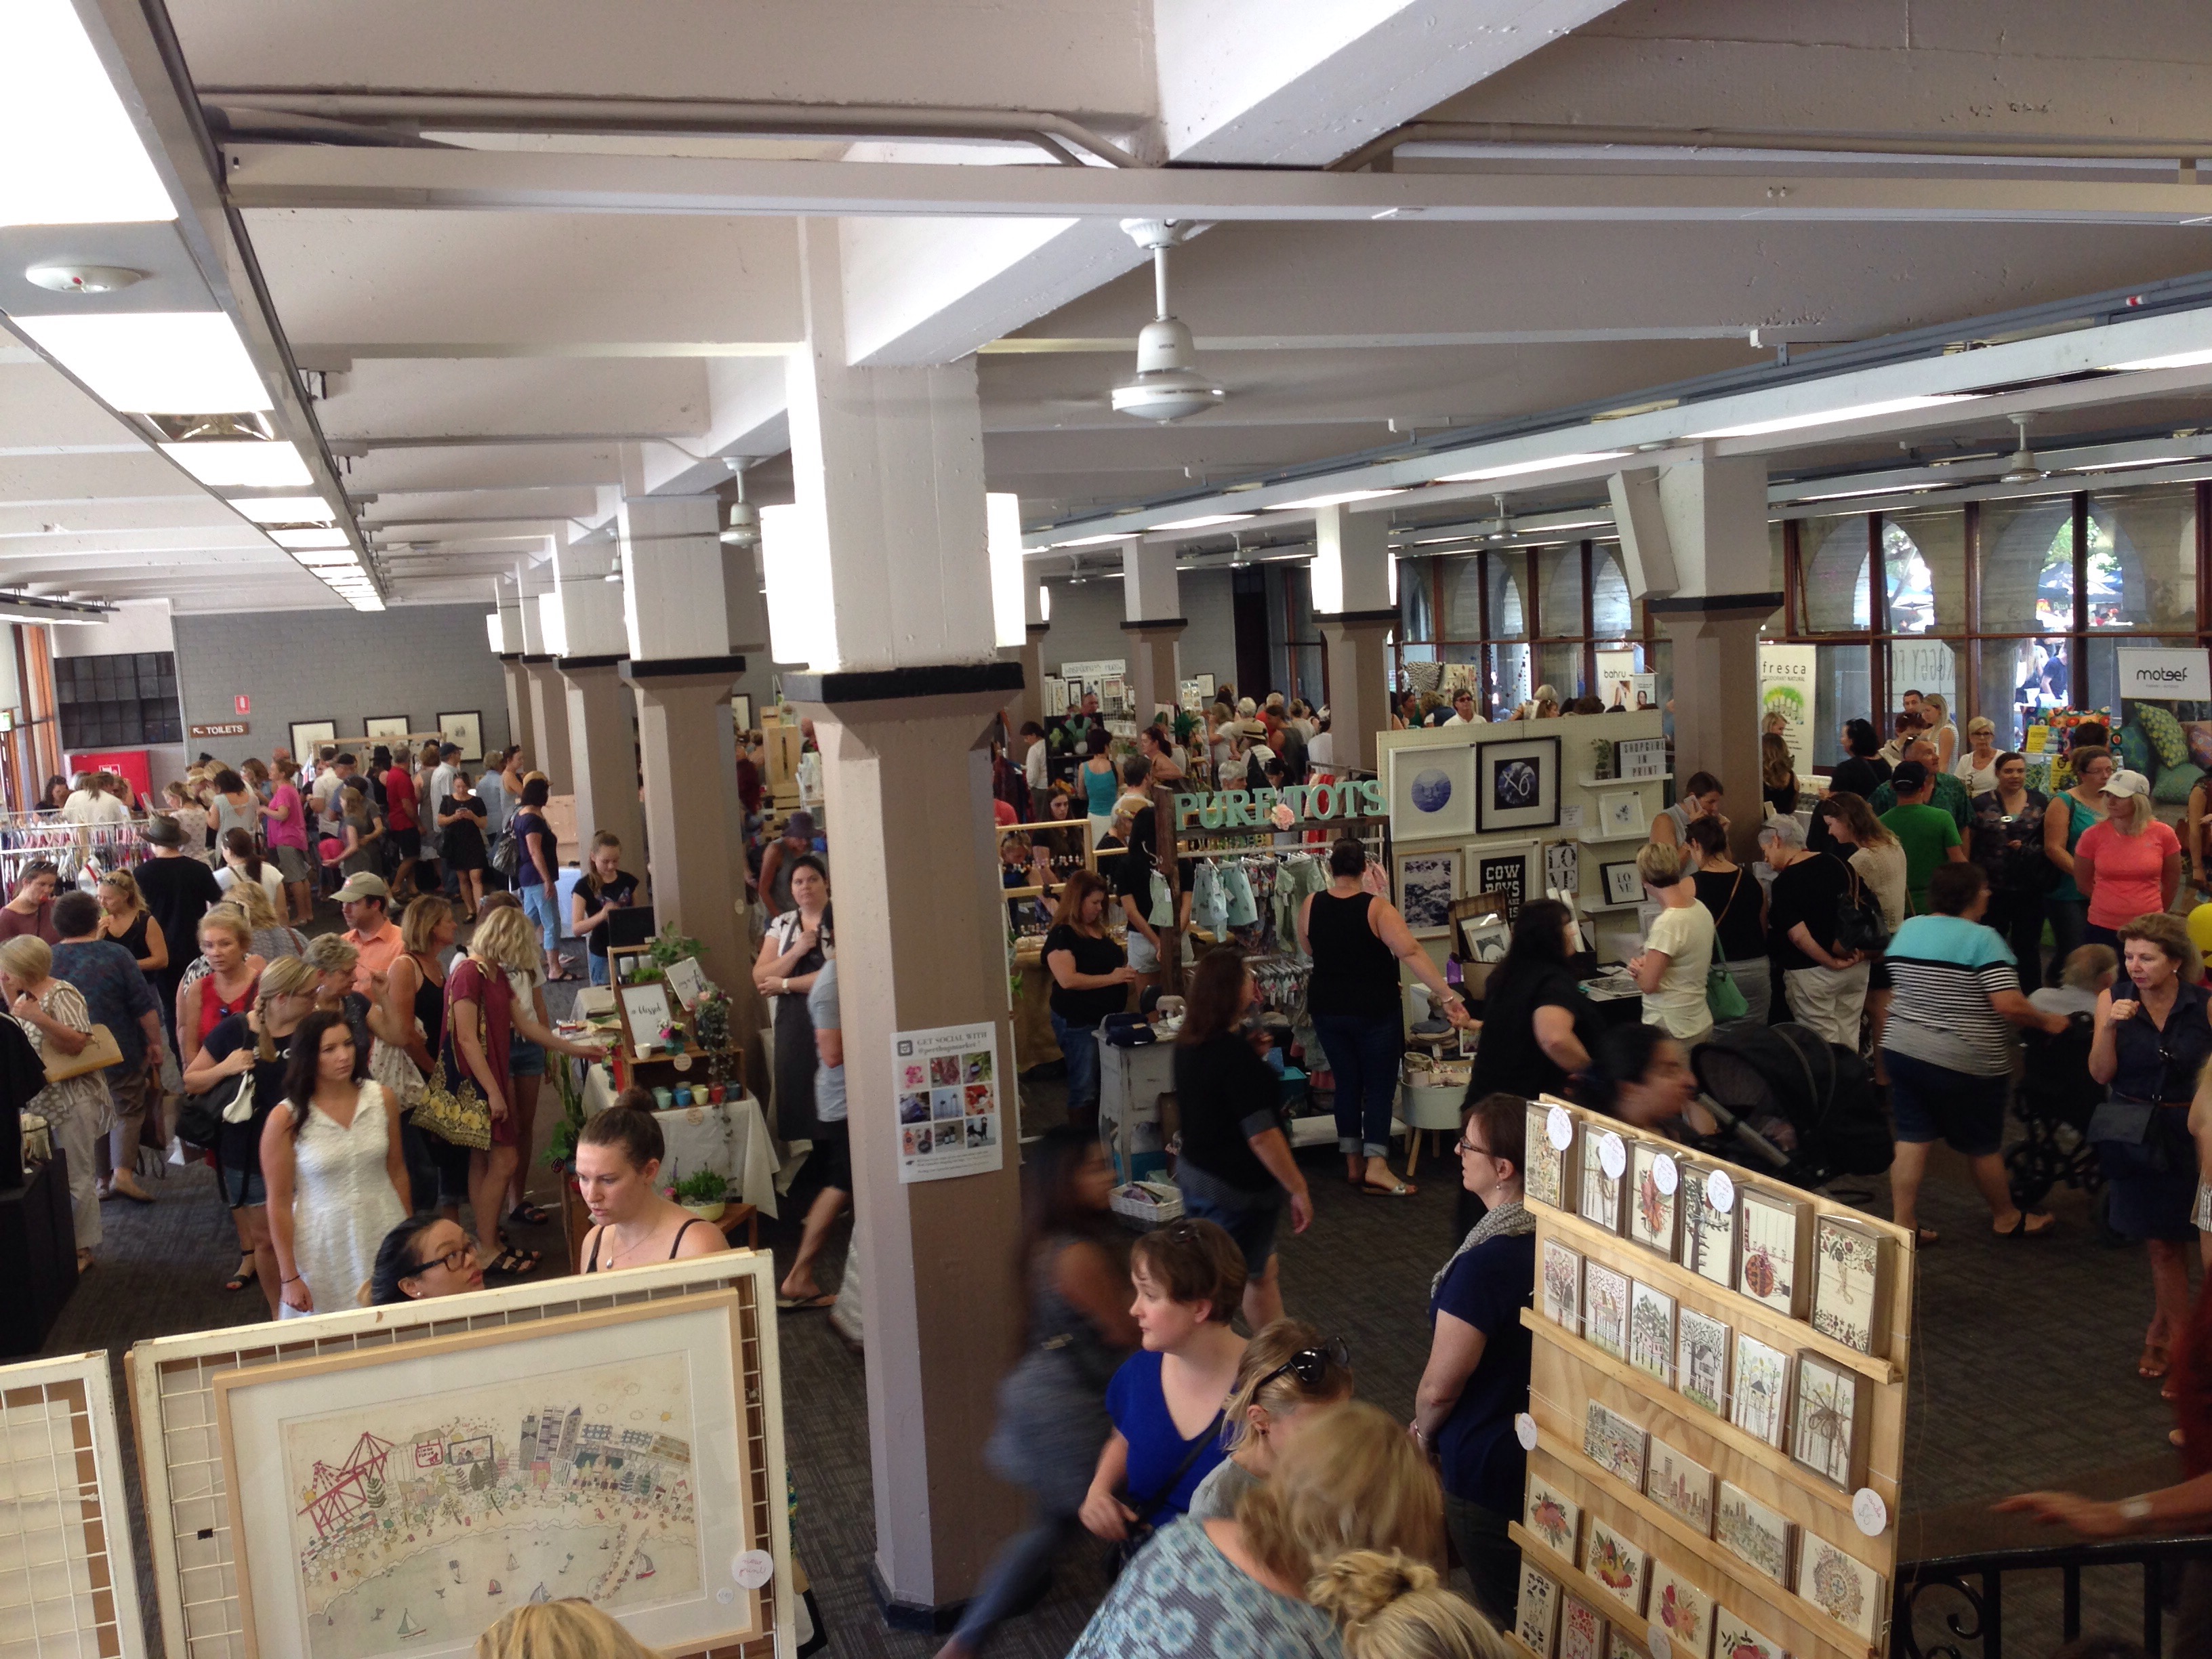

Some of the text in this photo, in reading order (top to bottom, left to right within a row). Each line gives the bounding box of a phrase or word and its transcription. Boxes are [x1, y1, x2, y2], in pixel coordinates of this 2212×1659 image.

[1763, 661, 1806, 674] fresca
[1603, 669, 1626, 678] bahru
[206, 725, 244, 735] TOILETS
[1639, 754, 1647, 764] IN
[1633, 765, 1657, 777] PRINT
[1174, 780, 1387, 831] PURE TOTS
[1486, 863, 1520, 881] COW
[935, 1034, 964, 1042] SOCIAL
[966, 1031, 987, 1040] WITH
